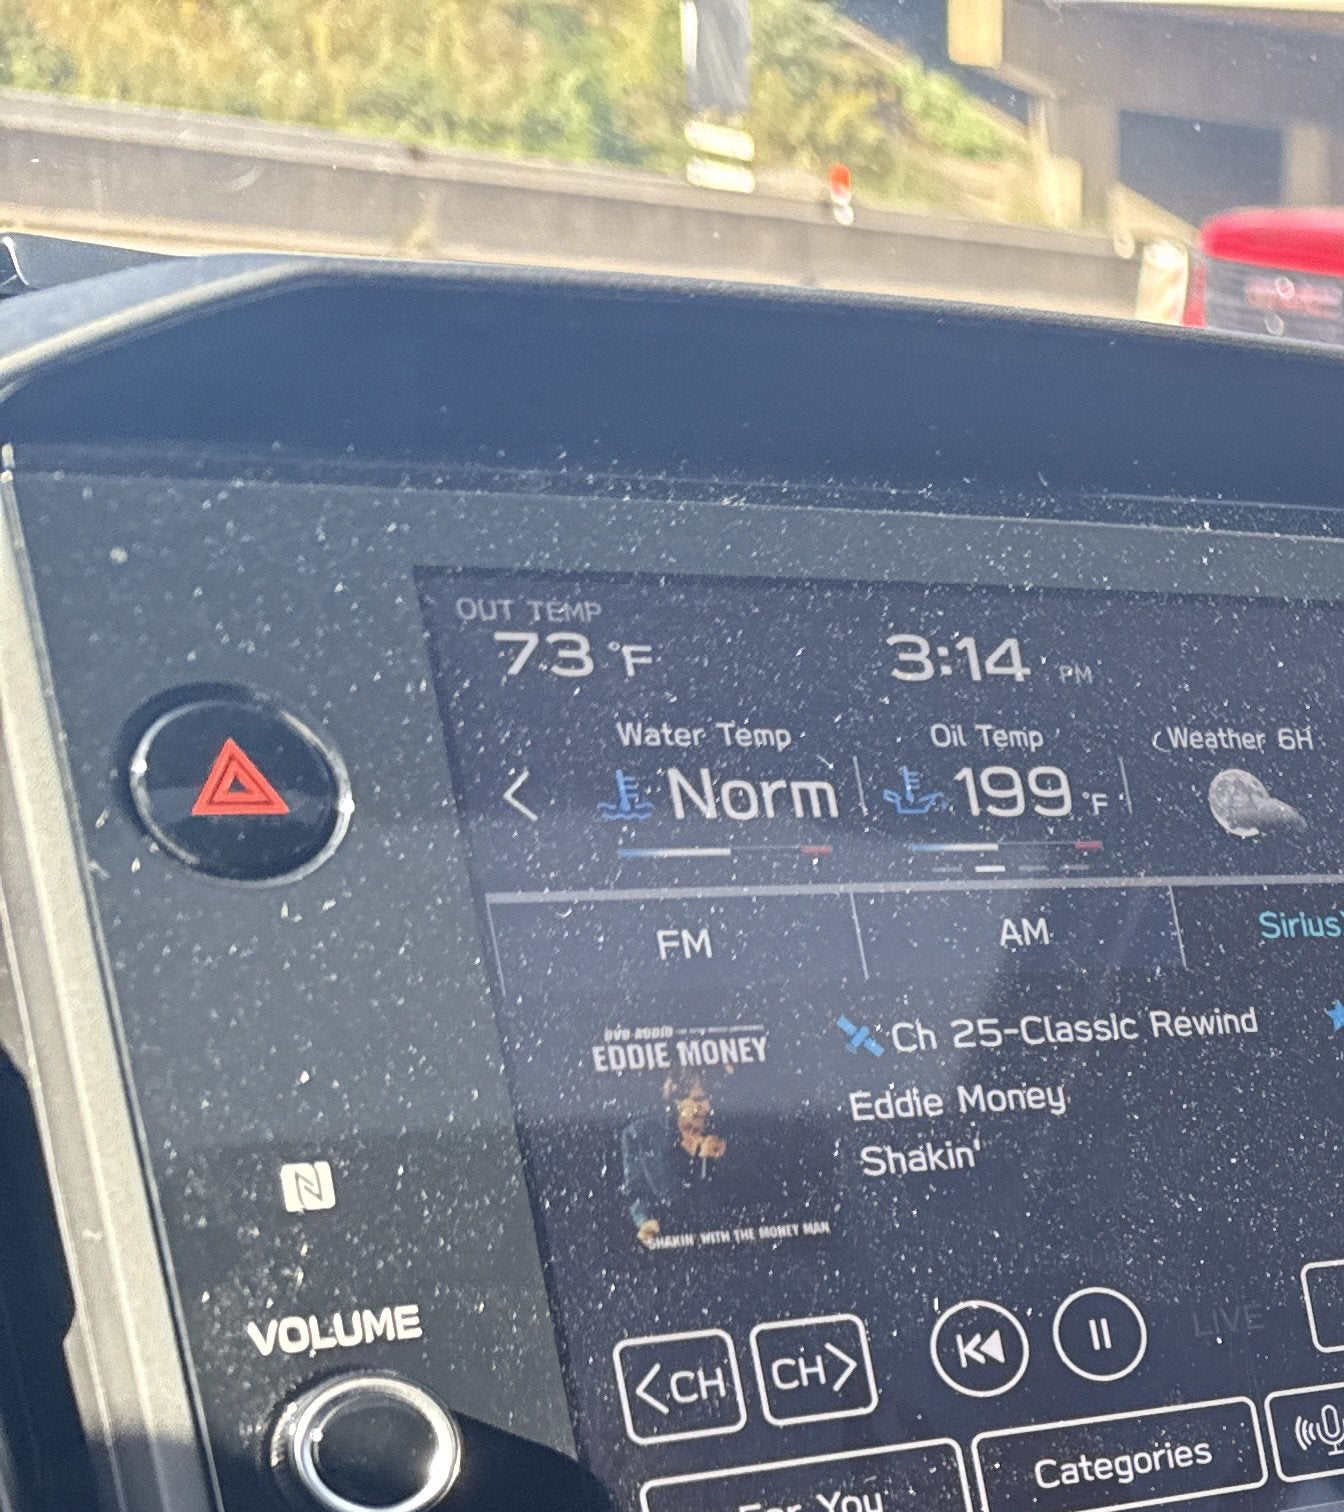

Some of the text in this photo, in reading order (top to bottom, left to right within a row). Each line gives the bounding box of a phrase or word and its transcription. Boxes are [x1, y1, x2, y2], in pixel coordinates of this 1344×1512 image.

[455, 599, 602, 623] OUT TEMP
[885, 634, 1092, 684] 3:14 PM
[616, 722, 791, 750] Water Temp
[931, 724, 1044, 751] Oil Temp
[1166, 726, 1314, 751] Weather 6H
[666, 768, 839, 820] Norm
[953, 766, 1072, 817] 199
[656, 929, 712, 960] FM
[1000, 918, 1050, 947] AM
[891, 1006, 1259, 1053] Ch 25-Classic Rewind
[592, 1036, 767, 1072] EDDIE MONEY
[849, 1083, 1067, 1122] Eddie Money
[860, 1137, 981, 1177] Shakin'
[700, 1230, 730, 1246] WITH
[733, 1227, 755, 1242] THE
[758, 1223, 800, 1240] MONEY
[802, 1220, 832, 1236] MAN
[247, 1304, 423, 1357] VOLUME
[1192, 1304, 1264, 1337] LIVE
[669, 1366, 727, 1404] CH
[770, 1354, 827, 1390] CH
[1034, 1440, 1214, 1490] Categories
